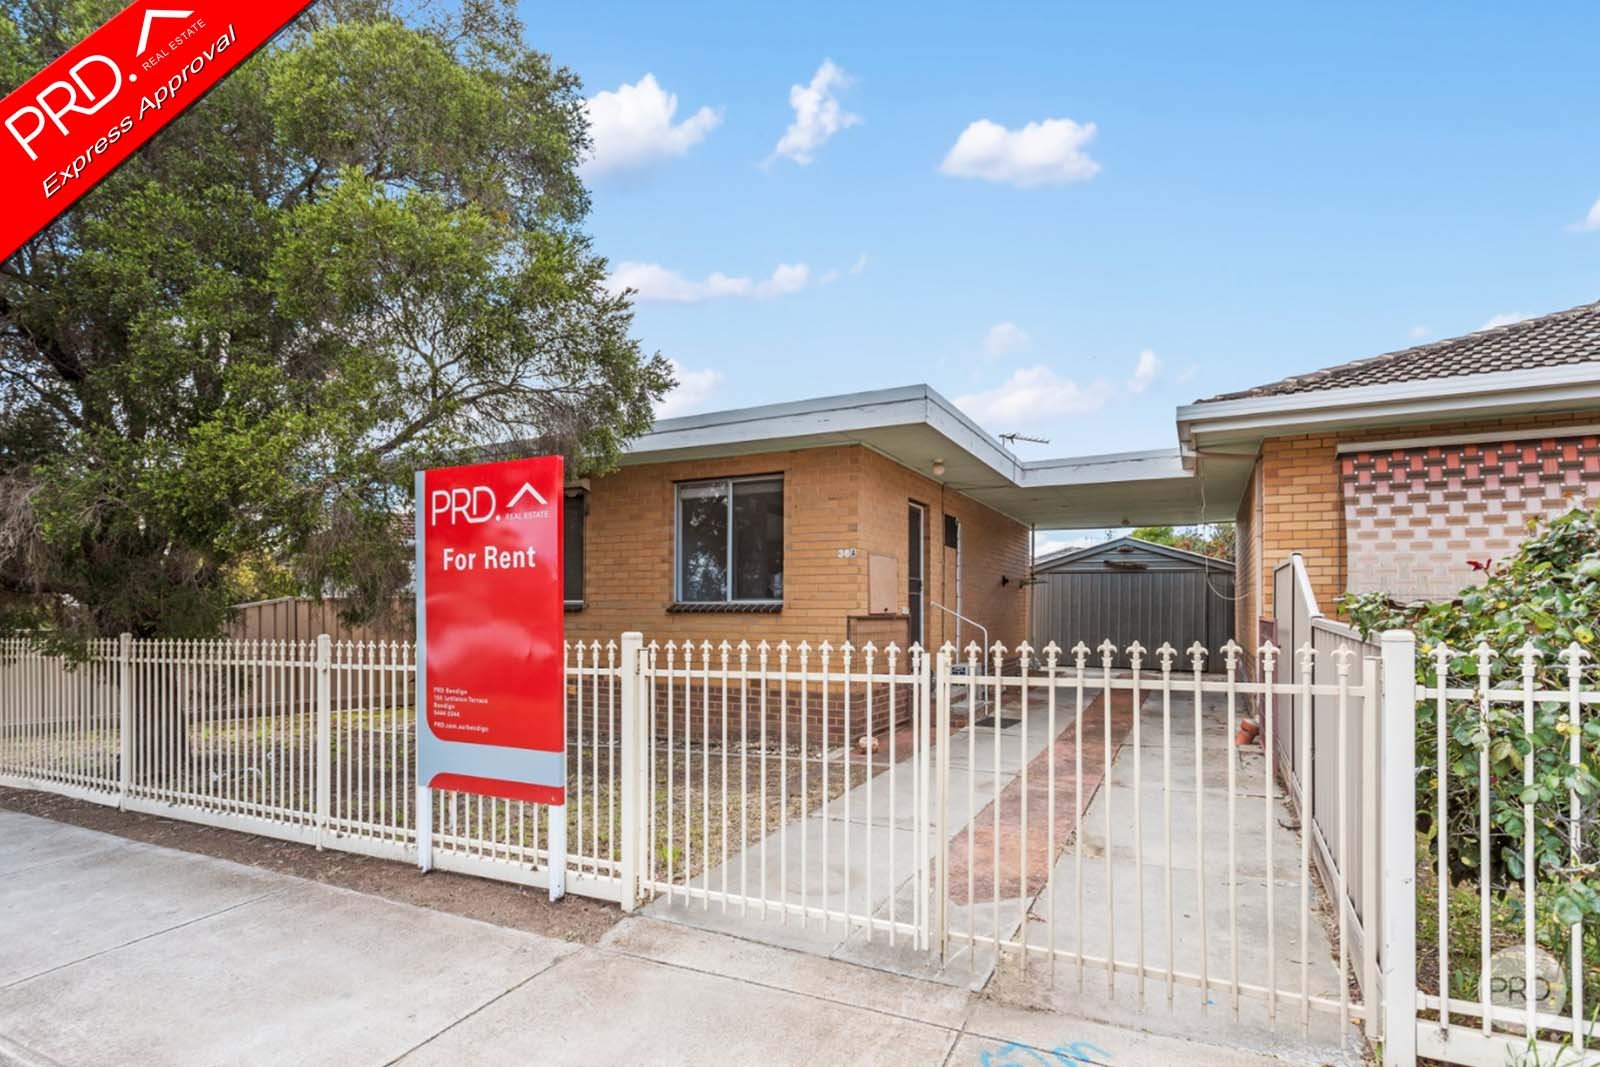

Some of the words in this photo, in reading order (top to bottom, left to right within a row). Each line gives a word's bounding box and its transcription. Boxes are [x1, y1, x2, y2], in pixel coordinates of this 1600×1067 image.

[505, 512, 523, 521] REAL
[523, 510, 549, 520] ESTATE
[443, 547, 477, 571] For
[484, 545, 537, 570] Rent
[446, 688, 468, 696] Bendigo
[468, 696, 488, 704] Terrace
[433, 702, 455, 710] Bendigo
